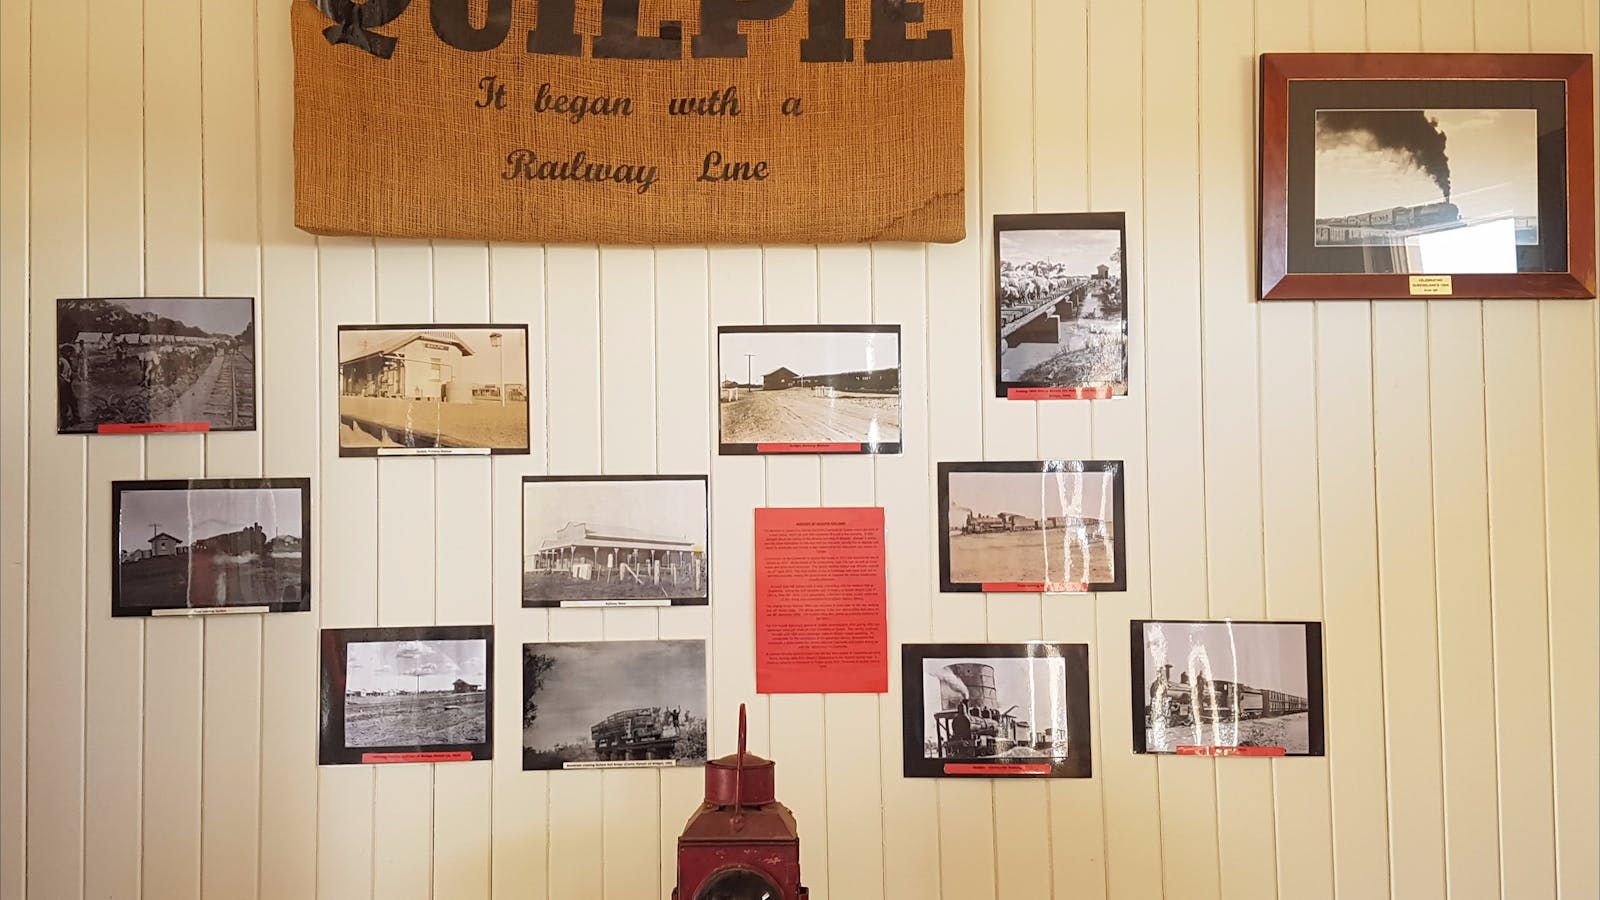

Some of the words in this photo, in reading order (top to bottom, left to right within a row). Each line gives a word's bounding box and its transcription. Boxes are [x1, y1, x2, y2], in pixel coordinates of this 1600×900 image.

[314, 0, 953, 63] QUILPIE
[475, 75, 508, 110] It
[535, 83, 633, 124] began
[669, 86, 741, 117] with
[781, 97, 803, 117] a
[502, 149, 657, 194] Railway
[697, 151, 769, 182] Line
